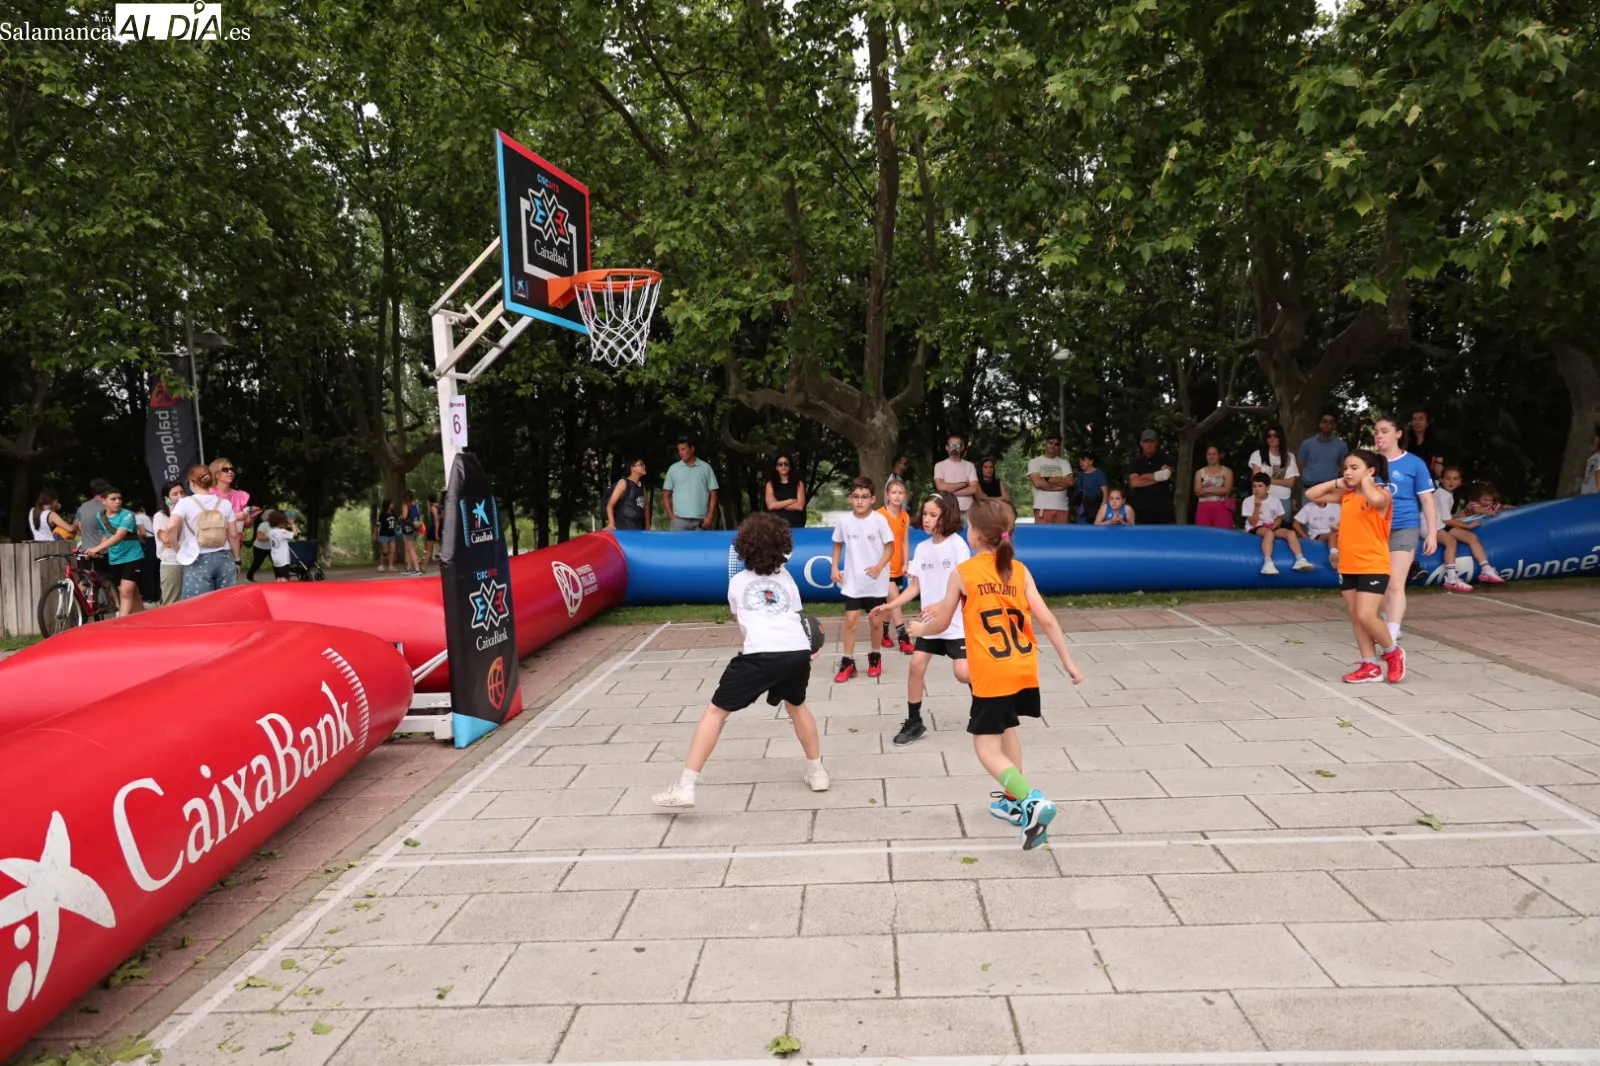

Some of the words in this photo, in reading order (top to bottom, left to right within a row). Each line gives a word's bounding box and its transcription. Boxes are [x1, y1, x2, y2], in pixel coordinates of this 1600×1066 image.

[534, 239, 568, 268] CaixaBank
[452, 413, 462, 435] 6
[476, 627, 508, 651] CaixaBank
[112, 680, 355, 892] CaixaBank
